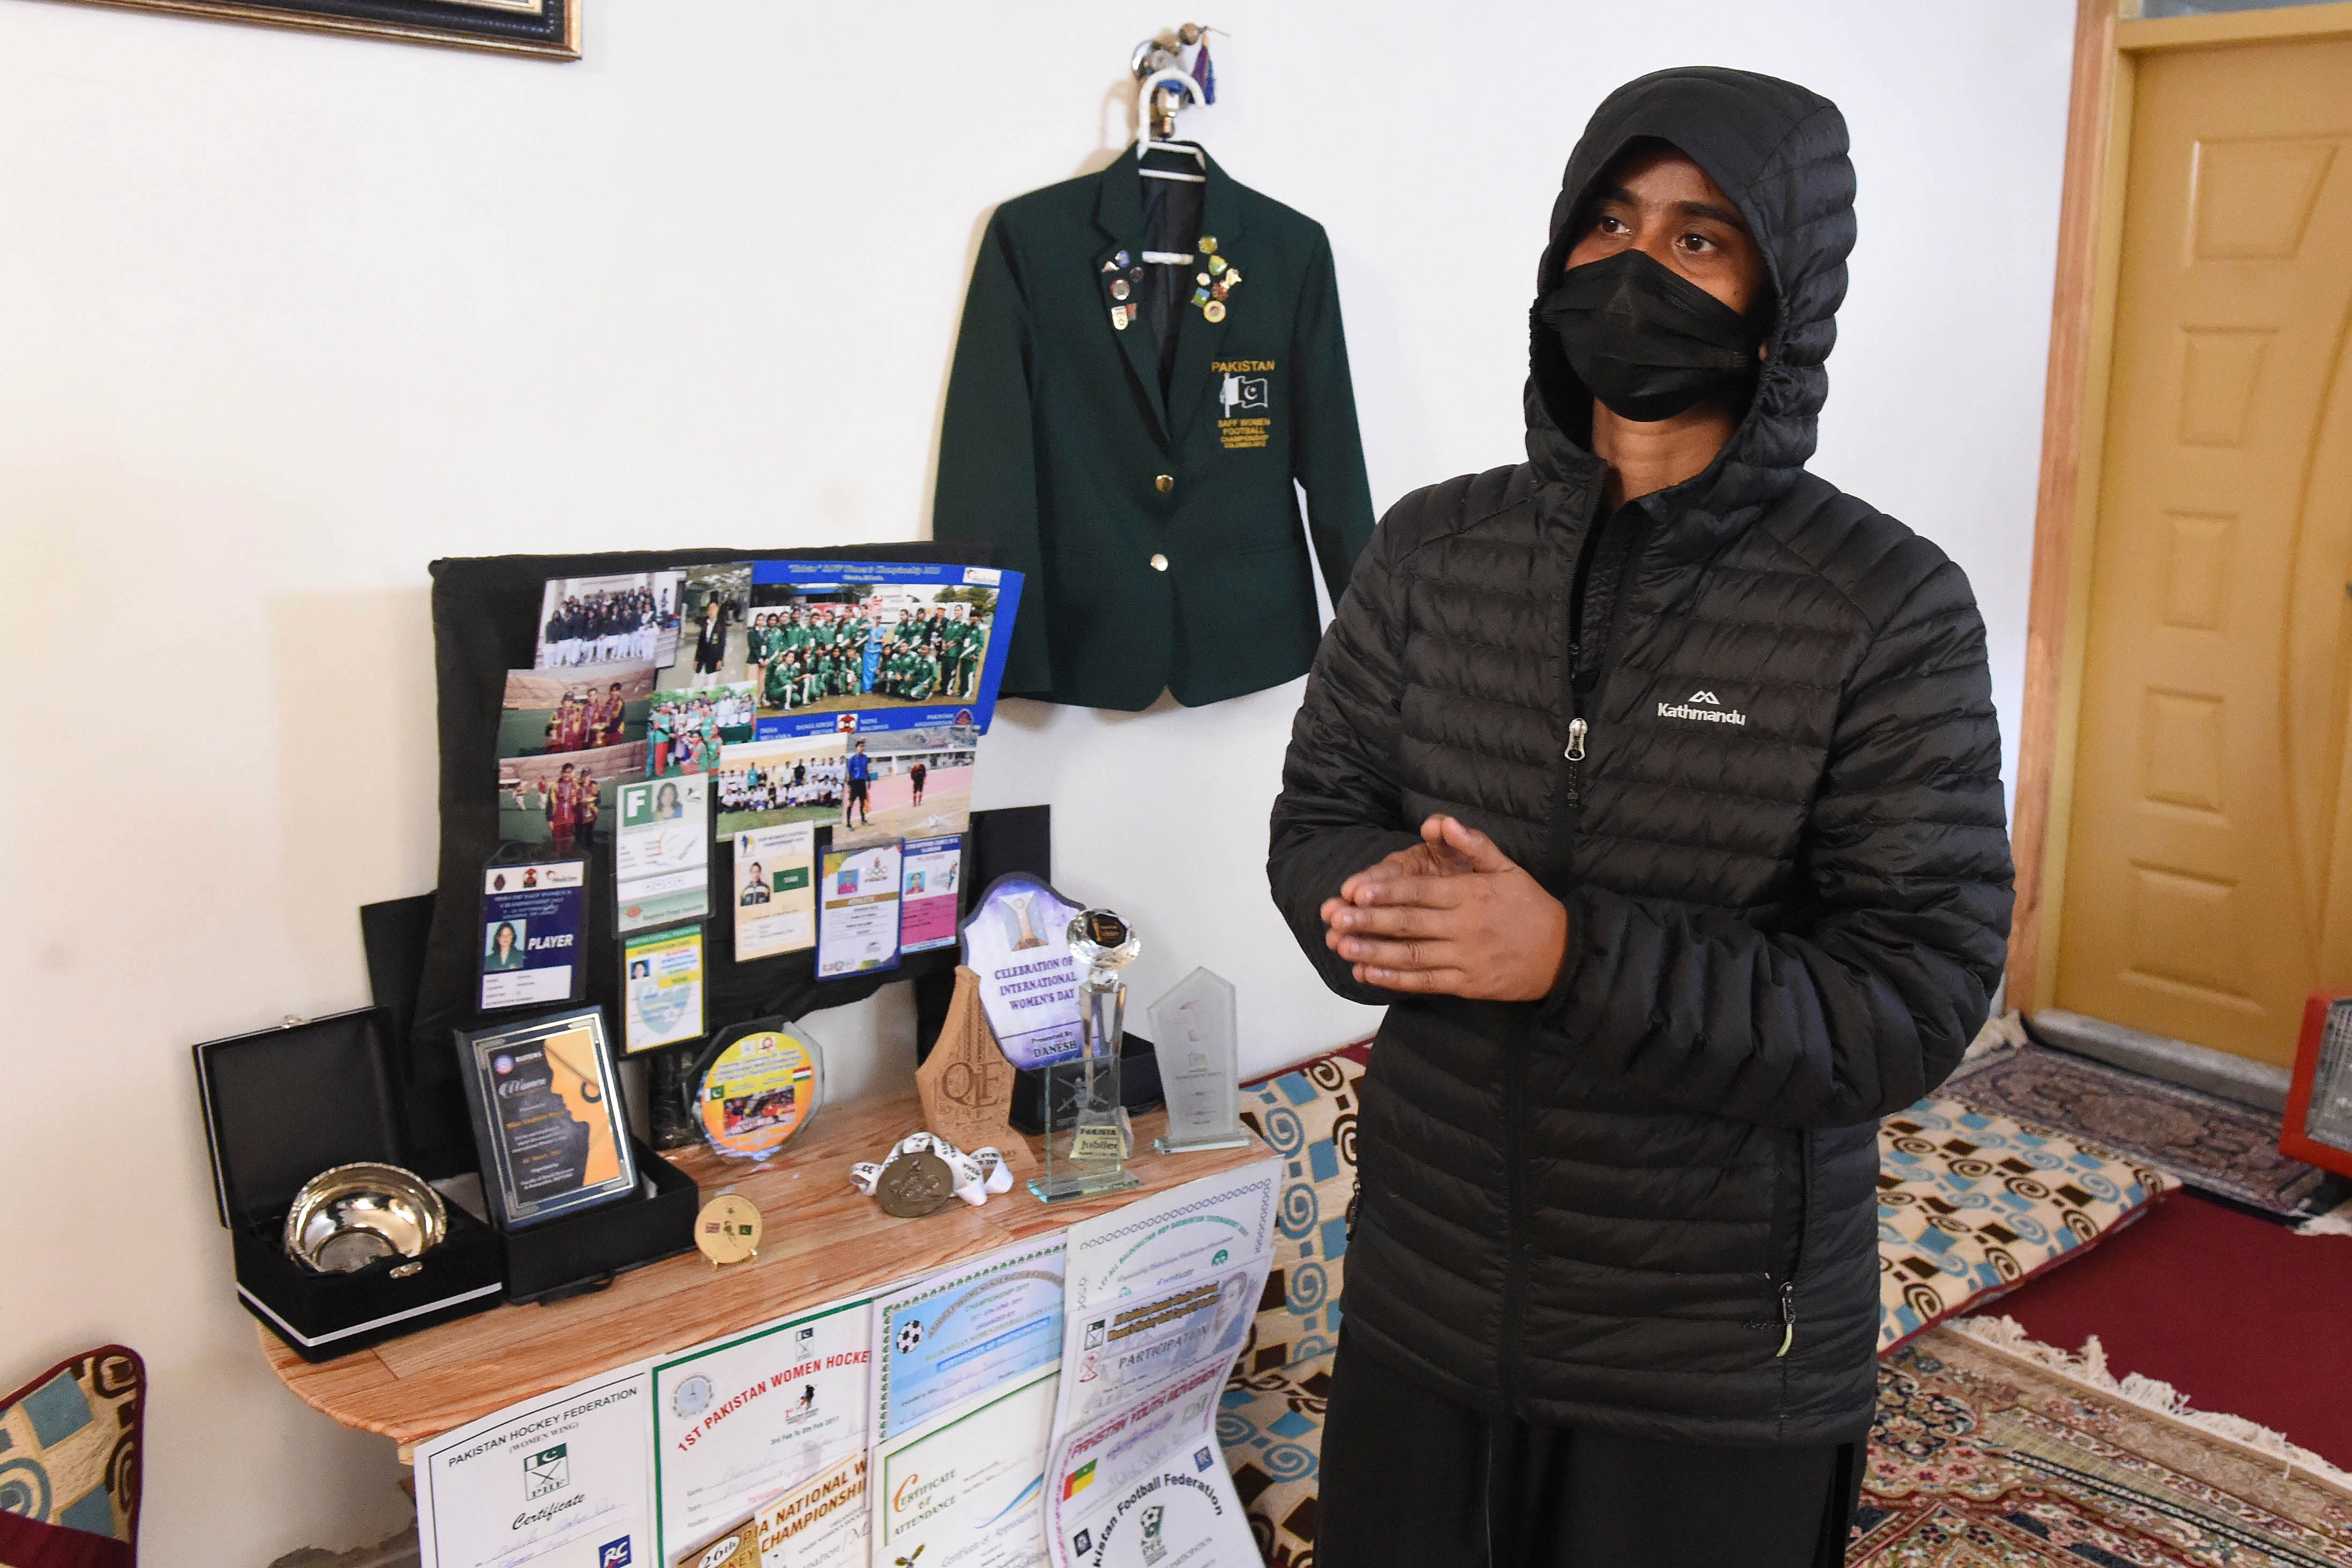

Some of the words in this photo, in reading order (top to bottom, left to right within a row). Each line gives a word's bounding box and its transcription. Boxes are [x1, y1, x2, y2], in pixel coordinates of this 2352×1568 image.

[1211, 360, 1276, 372] PAKISTAN
[1658, 703, 1746, 726] Kathmandu
[627, 789, 646, 817] F
[528, 934, 574, 950] PLAYER
[995, 959, 1060, 980] CELEBRATION
[1062, 956, 1074, 967] OF
[1000, 972, 1077, 996] INTERNATIONAL
[1010, 993, 1055, 1010] WOMEN'S
[1057, 988, 1075, 1000] DAY
[678, 1426, 702, 1451] 1ST
[704, 1381, 766, 1429] PAKISTAN
[771, 1359, 821, 1387] WOMEN
[449, 1435, 507, 1467] PAKISTAN
[510, 1415, 560, 1440] HOCKEY
[563, 1387, 637, 1421] FEDERATION
[531, 1479, 565, 1497] PHF
[1117, 1476, 1162, 1516] Football
[1164, 1473, 1223, 1516] Federation
[512, 1493, 585, 1530] Certificate
[742, 1520, 769, 1546] PIA
[776, 1471, 848, 1526] NATIONAL
[895, 1495, 956, 1535] ATTENDANCE
